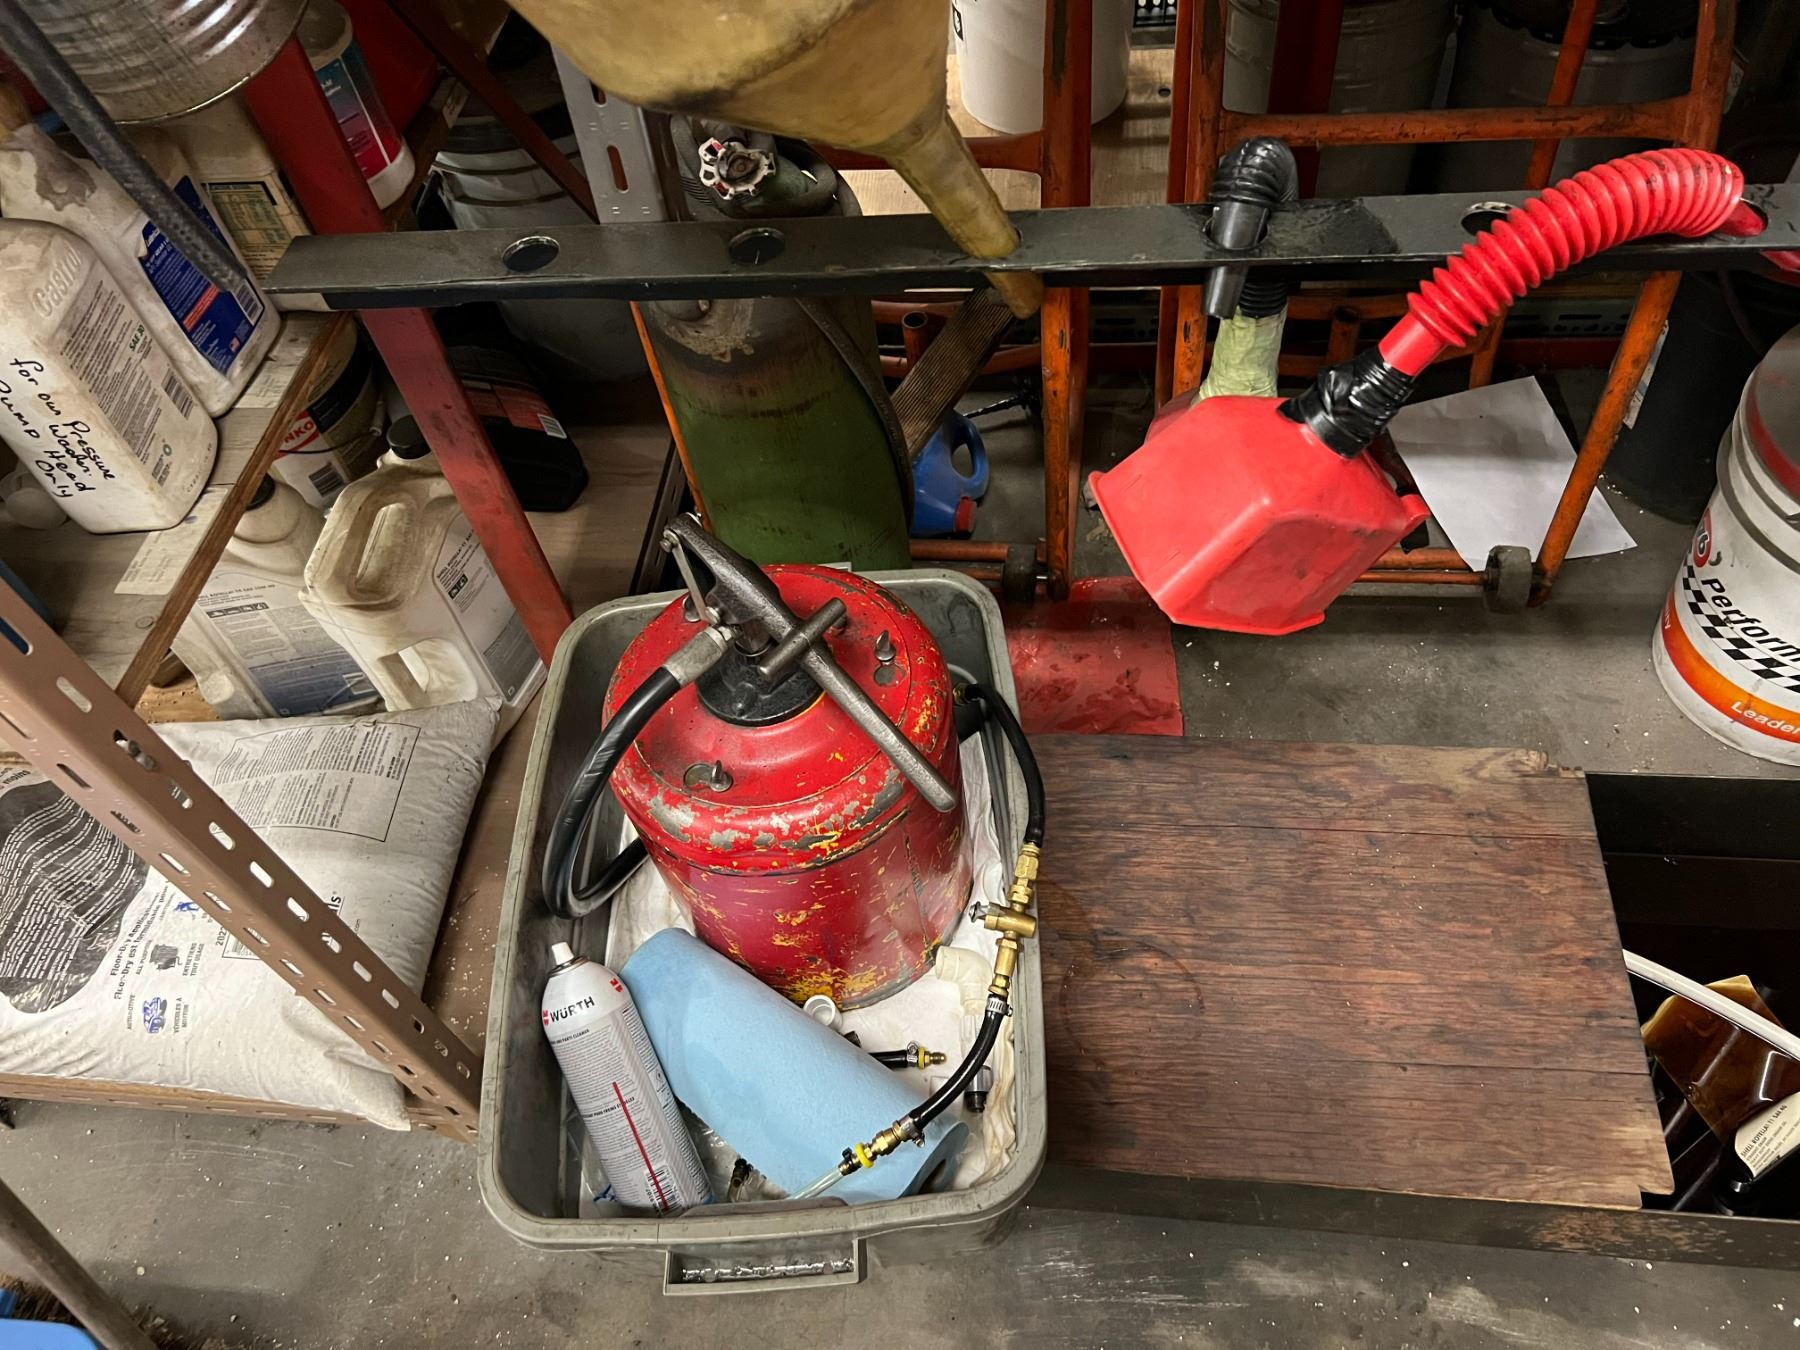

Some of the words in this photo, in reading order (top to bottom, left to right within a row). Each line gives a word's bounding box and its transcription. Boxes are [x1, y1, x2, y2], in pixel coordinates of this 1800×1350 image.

[0, 380, 40, 438] Pump
[43, 450, 97, 492] Head
[62, 420, 115, 480] Pressure
